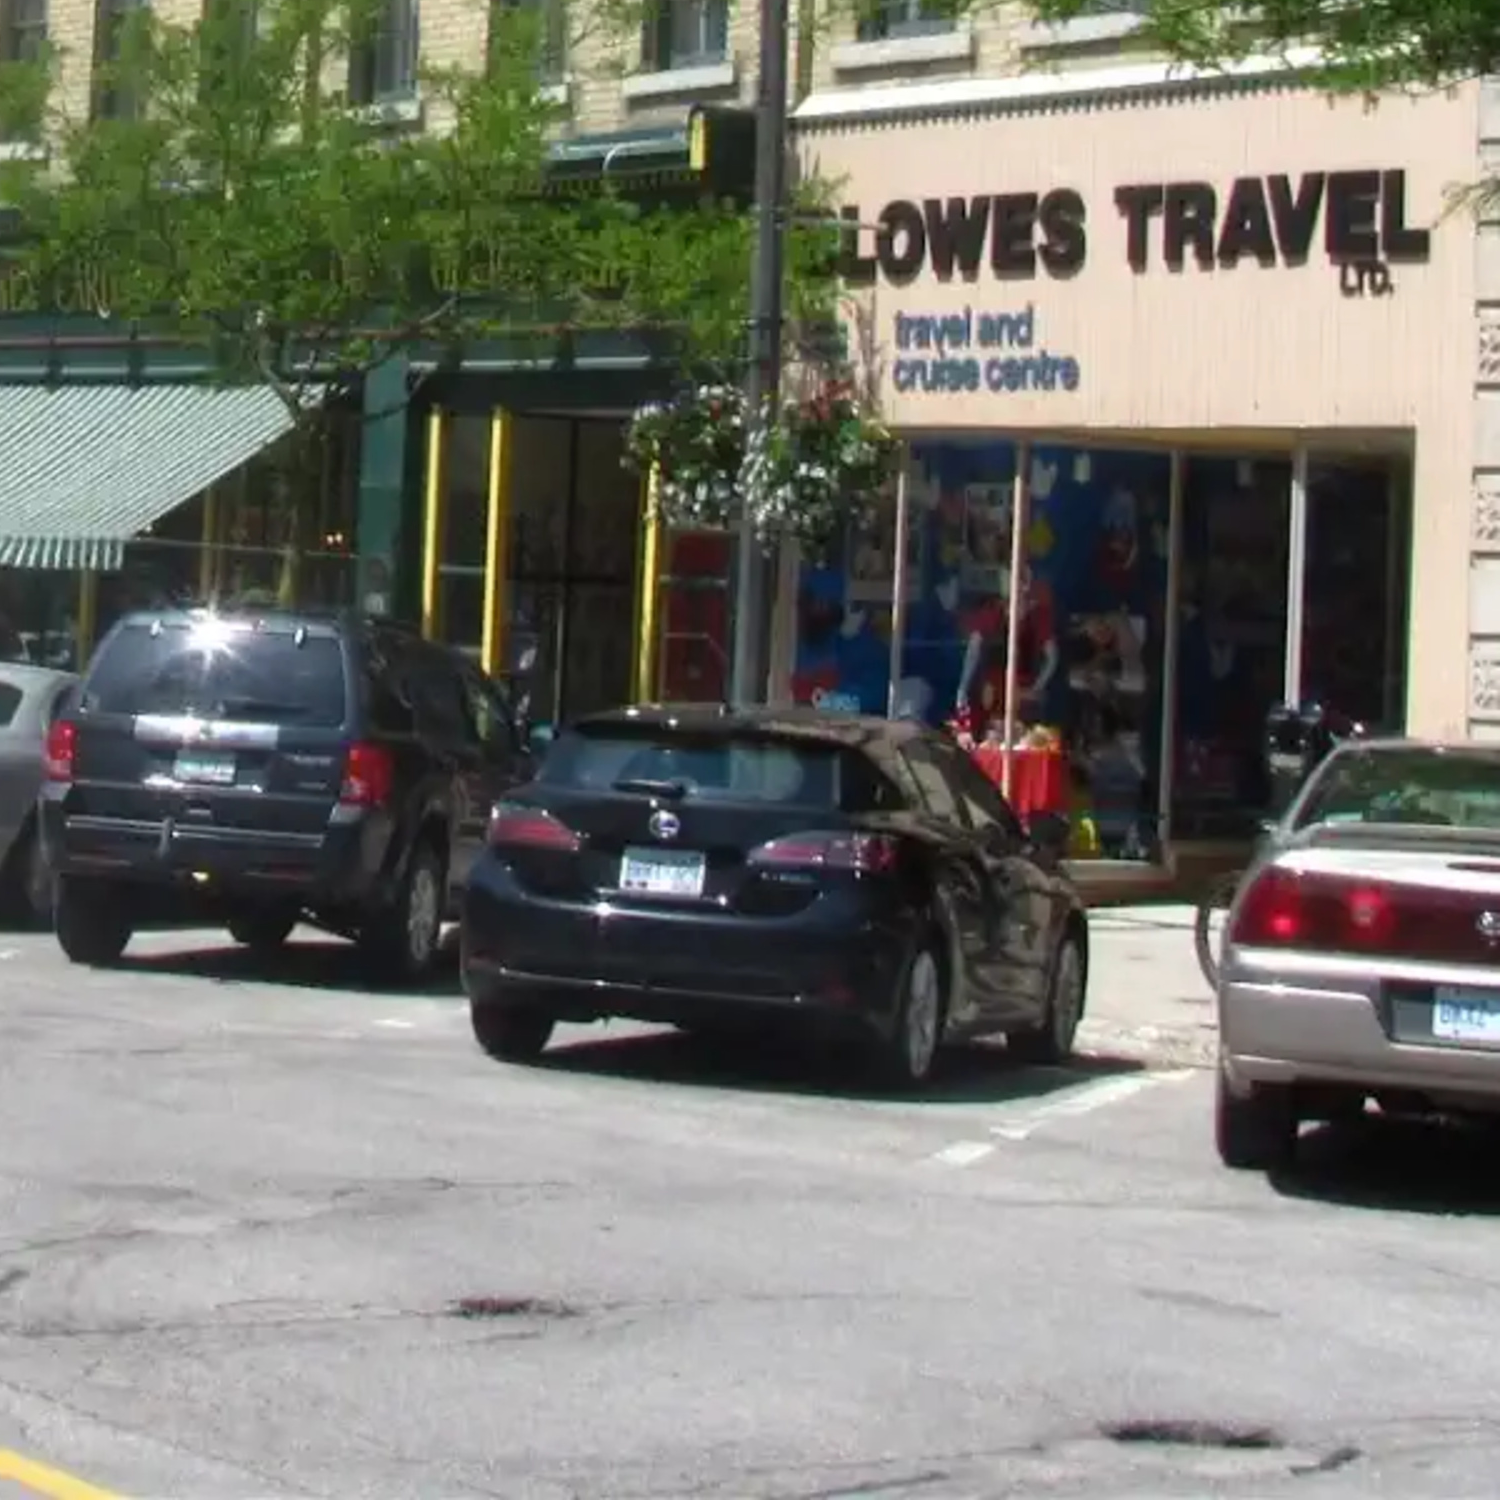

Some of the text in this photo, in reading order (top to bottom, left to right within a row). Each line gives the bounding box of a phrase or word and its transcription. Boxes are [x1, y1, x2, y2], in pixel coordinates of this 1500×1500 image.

[835, 168, 1430, 289] LOWES TRAVEL
[895, 299, 1034, 349] travel and
[892, 349, 1080, 393] cruise centre
